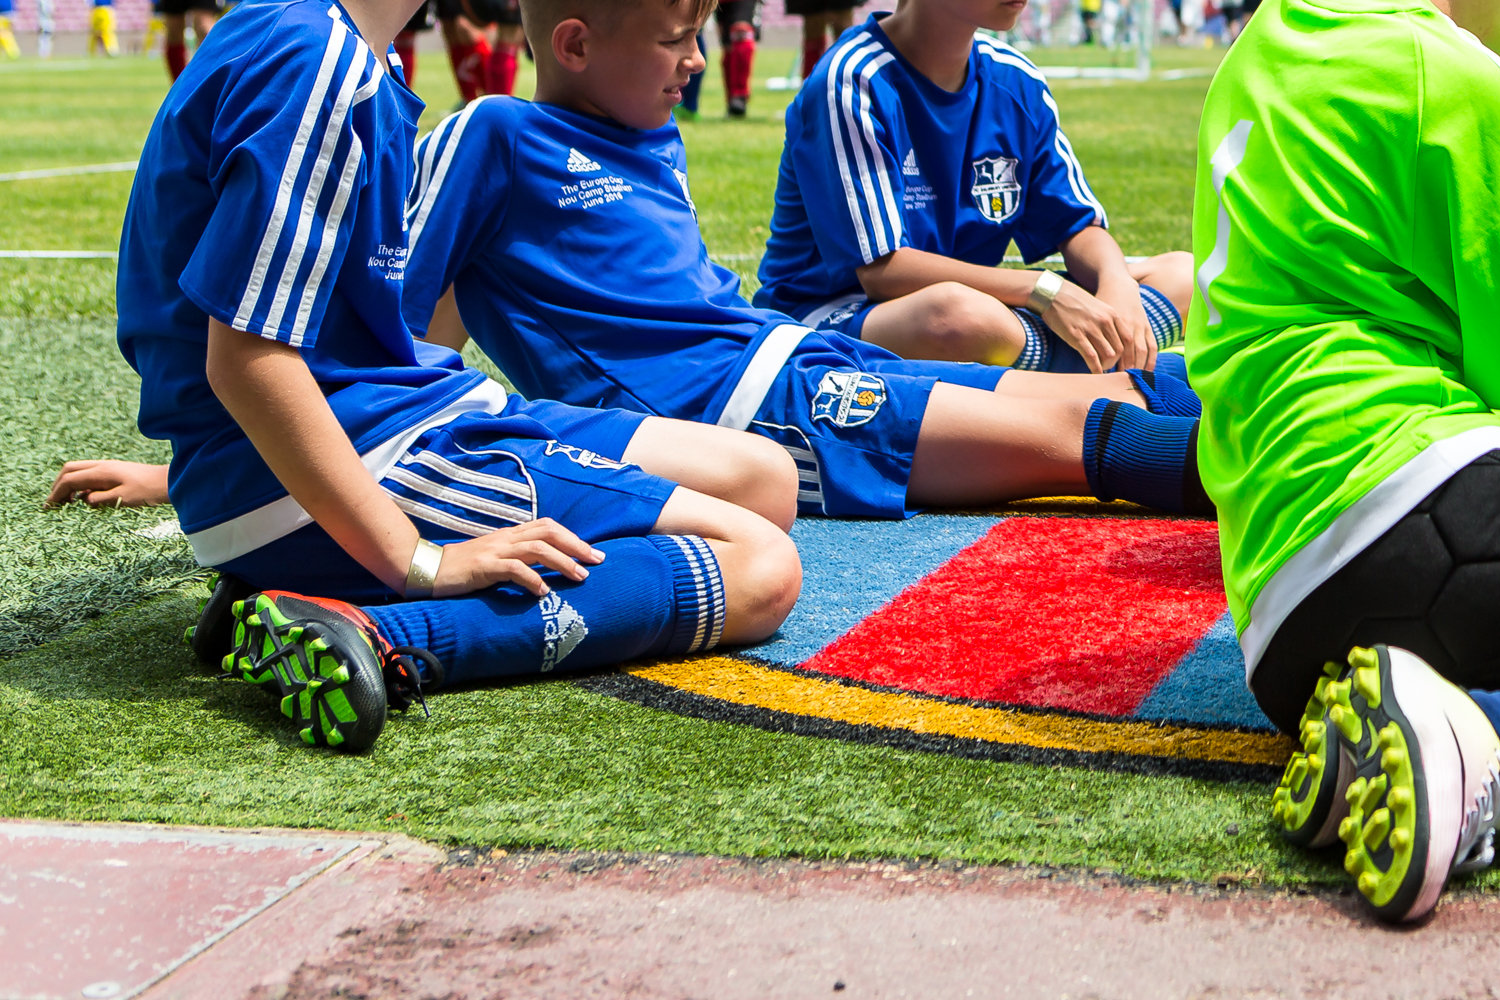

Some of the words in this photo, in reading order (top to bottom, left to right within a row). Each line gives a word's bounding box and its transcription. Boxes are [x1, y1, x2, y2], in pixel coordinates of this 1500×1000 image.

[567, 161, 602, 173] adidas
[561, 185, 579, 196] The
[580, 177, 609, 190] Europa
[608, 176, 624, 185] Cup
[558, 195, 578, 209] Nou
[578, 186, 604, 200] Camp
[582, 197, 604, 210] June
[603, 192, 624, 203] 2016
[1197, 119, 1254, 326] 1
[378, 244, 394, 256] The
